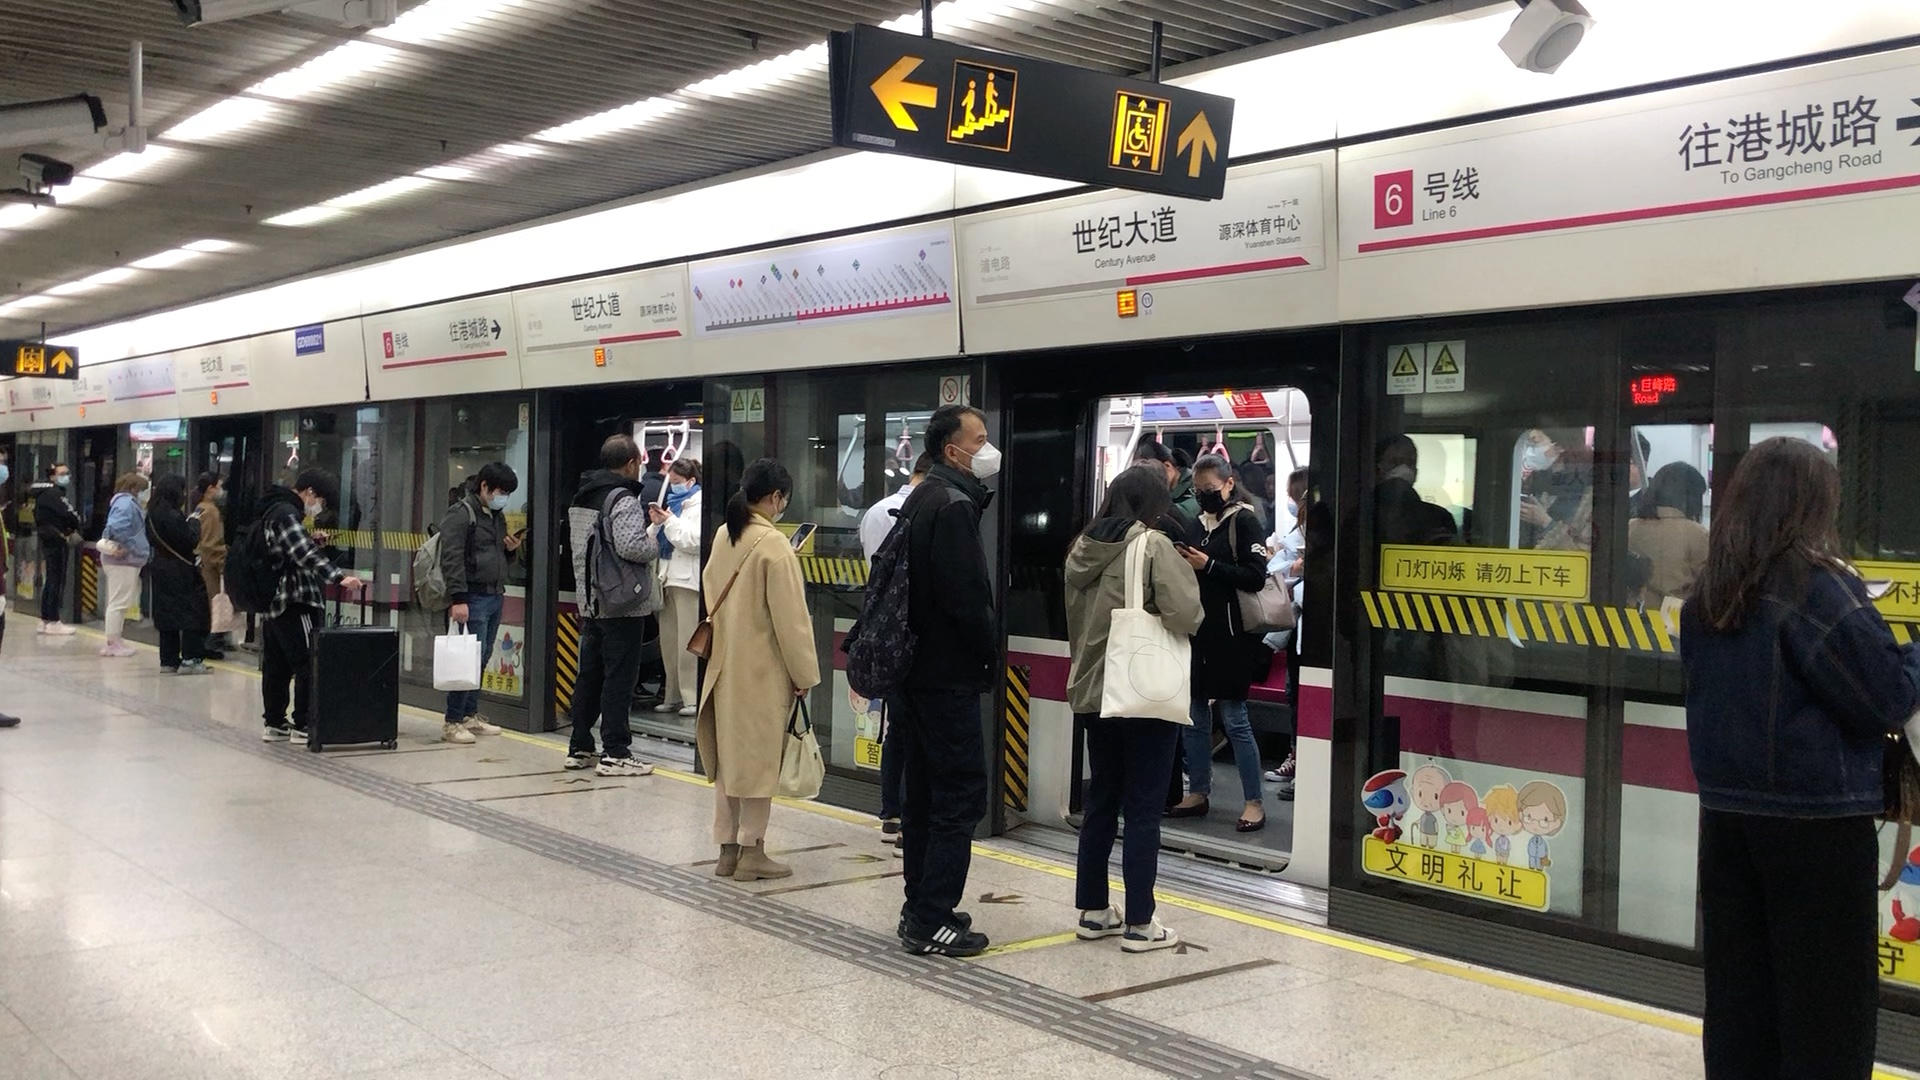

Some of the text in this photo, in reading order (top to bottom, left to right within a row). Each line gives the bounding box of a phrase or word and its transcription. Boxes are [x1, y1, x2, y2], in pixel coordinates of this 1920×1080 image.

[1678, 94, 1881, 173] 往港城路
[1720, 149, 1883, 185] To Gangcheng Road
[1383, 183, 1404, 216] 6
[1422, 166, 1481, 204] 号线
[1218, 213, 1302, 241] 源深体育中心
[1422, 205, 1458, 222] Line 6
[1072, 205, 1180, 255] 世纪大道
[1094, 252, 1157, 270] Century Avenue
[571, 291, 622, 322] 世纪大道
[385, 336, 393, 354] 6
[1634, 392, 1659, 404] Road
[1251, 543, 1267, 557] 23
[1396, 558, 1572, 588] 门灯闪烁 请勿上下车
[1385, 846, 1522, 900] 文明礼让
